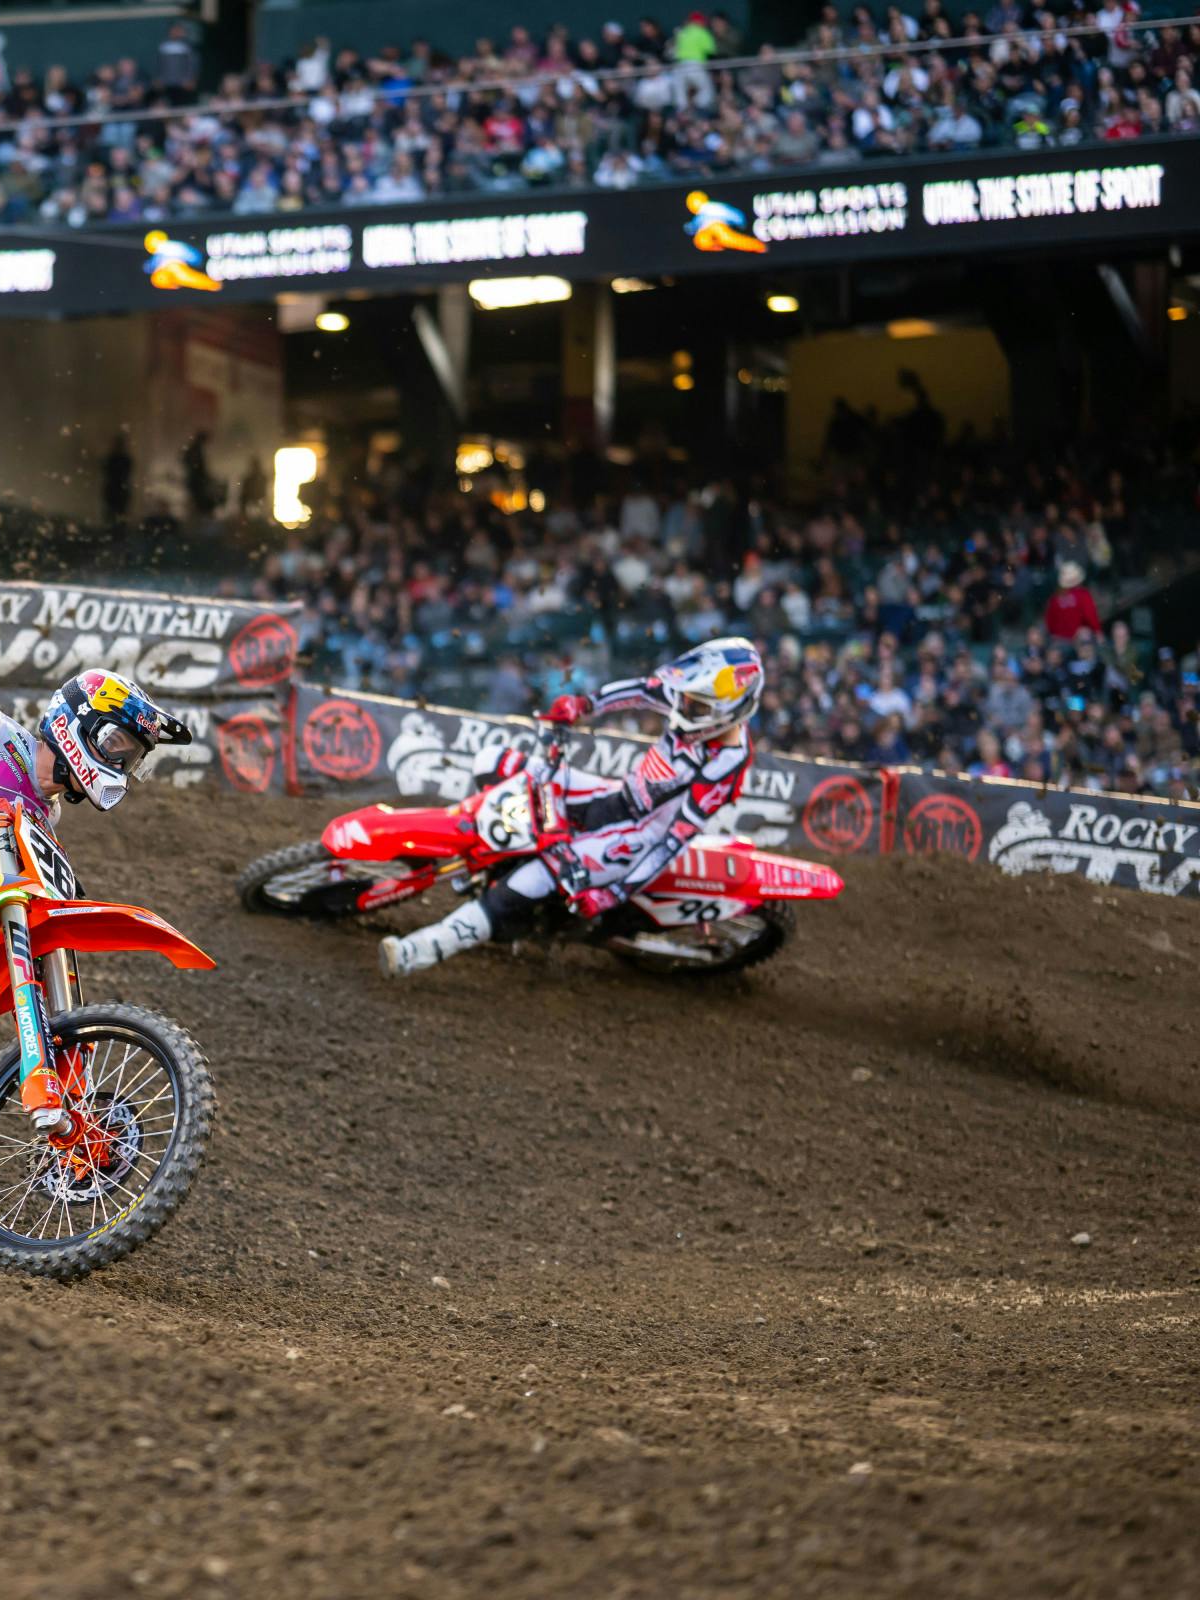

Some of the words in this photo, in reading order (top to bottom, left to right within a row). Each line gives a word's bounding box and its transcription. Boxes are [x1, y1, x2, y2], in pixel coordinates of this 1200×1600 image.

[32, 589, 233, 640] MOUNTAIN
[1058, 803, 1198, 853] ROCKY
[678, 899, 721, 922] 96
[18, 1005, 39, 1059] MOTOREX
